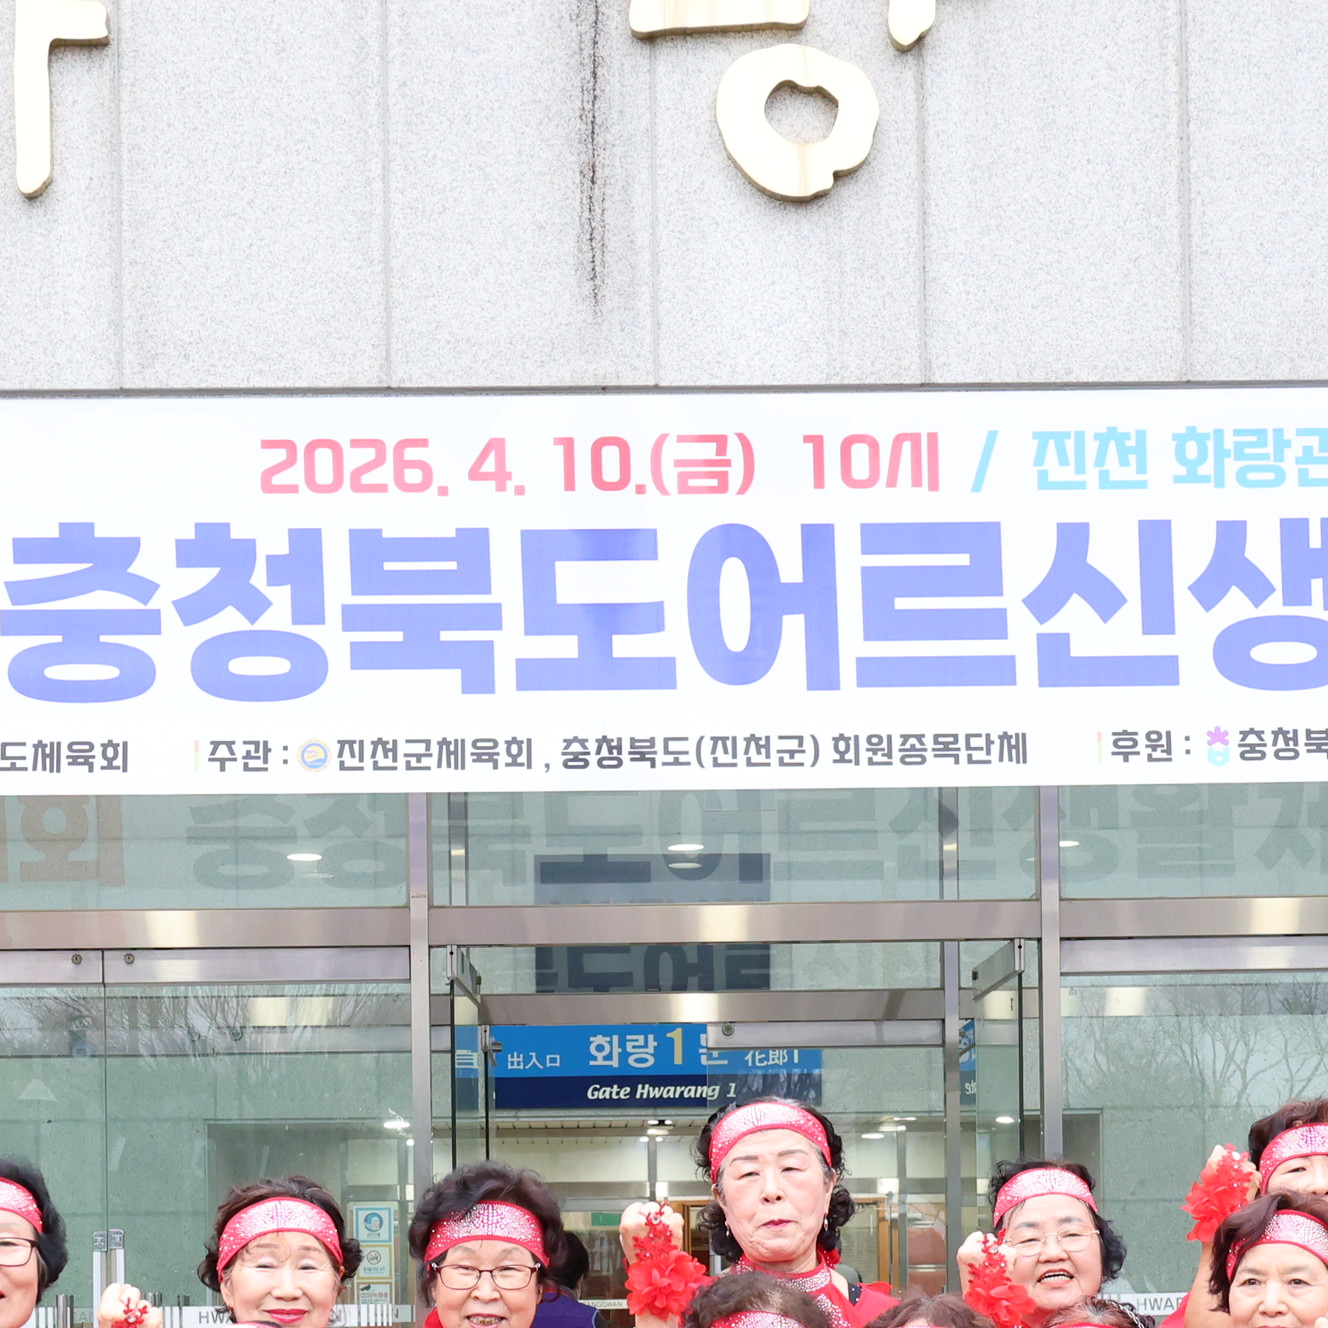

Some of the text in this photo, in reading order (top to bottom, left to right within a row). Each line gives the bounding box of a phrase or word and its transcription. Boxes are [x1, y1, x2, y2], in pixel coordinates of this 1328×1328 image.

[261, 439, 449, 497] 2026.
[468, 438, 525, 496] 4.
[553, 433, 755, 497] 10.(금)
[802, 433, 940, 492] 10시
[1033, 427, 1148, 490] 진천
[561, 733, 820, 770] 충청북도(진천군)
[831, 731, 1028, 768] 회원종목단체
[506, 1051, 562, 1071] 出入口
[586, 1083, 630, 1100] Gate
[635, 1082, 721, 1101] Hwarang
